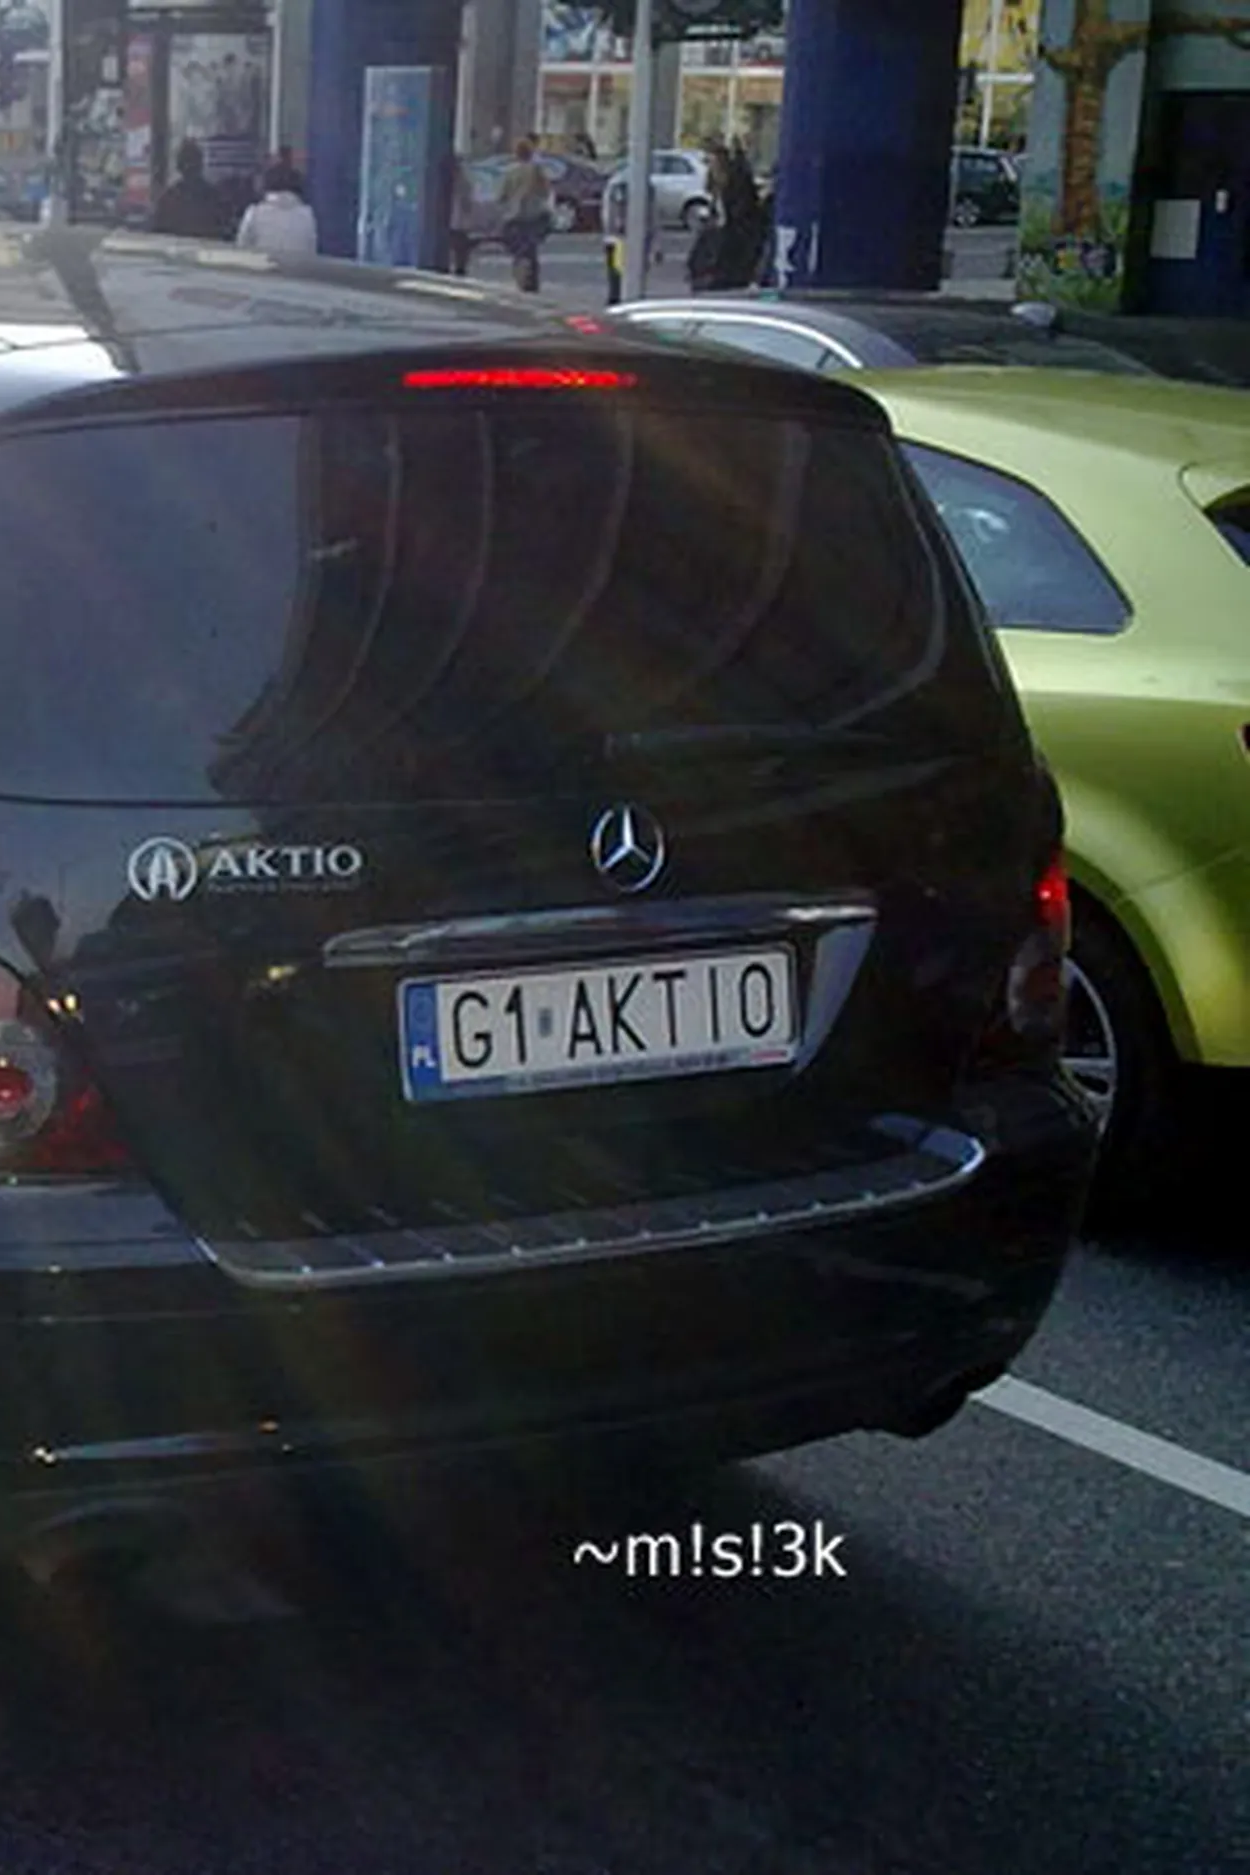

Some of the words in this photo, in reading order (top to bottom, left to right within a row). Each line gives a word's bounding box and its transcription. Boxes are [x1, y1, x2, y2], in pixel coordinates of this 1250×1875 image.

[208, 845, 364, 878] AKTIO
[452, 985, 527, 1069] G1
[568, 963, 775, 1060] AKTIO
[412, 1045, 437, 1069] PL
